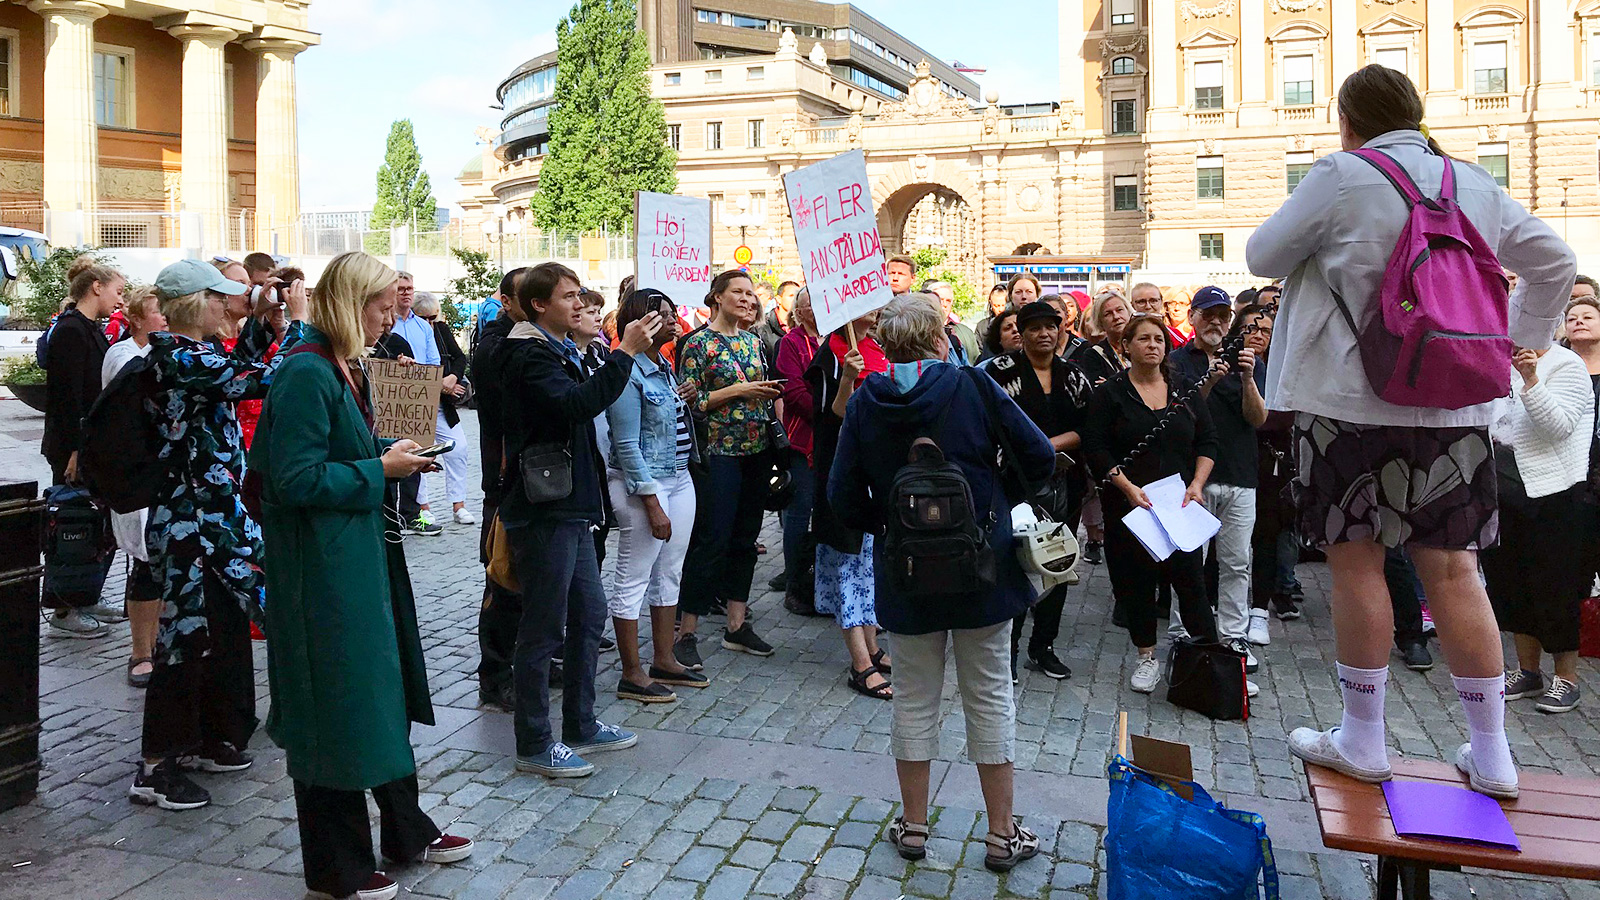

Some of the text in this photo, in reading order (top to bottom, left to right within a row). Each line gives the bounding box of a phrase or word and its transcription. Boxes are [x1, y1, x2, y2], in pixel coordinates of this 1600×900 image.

[813, 183, 866, 229] FLER
[652, 241, 700, 261] LÖNEN
[811, 227, 883, 283] ANSTÄLLDA
[664, 264, 709, 283] VÅRDEN!
[834, 262, 889, 304] VÅRDEN!
[387, 383, 429, 400] HÖGA
[377, 418, 431, 435] ÖTERSKA
